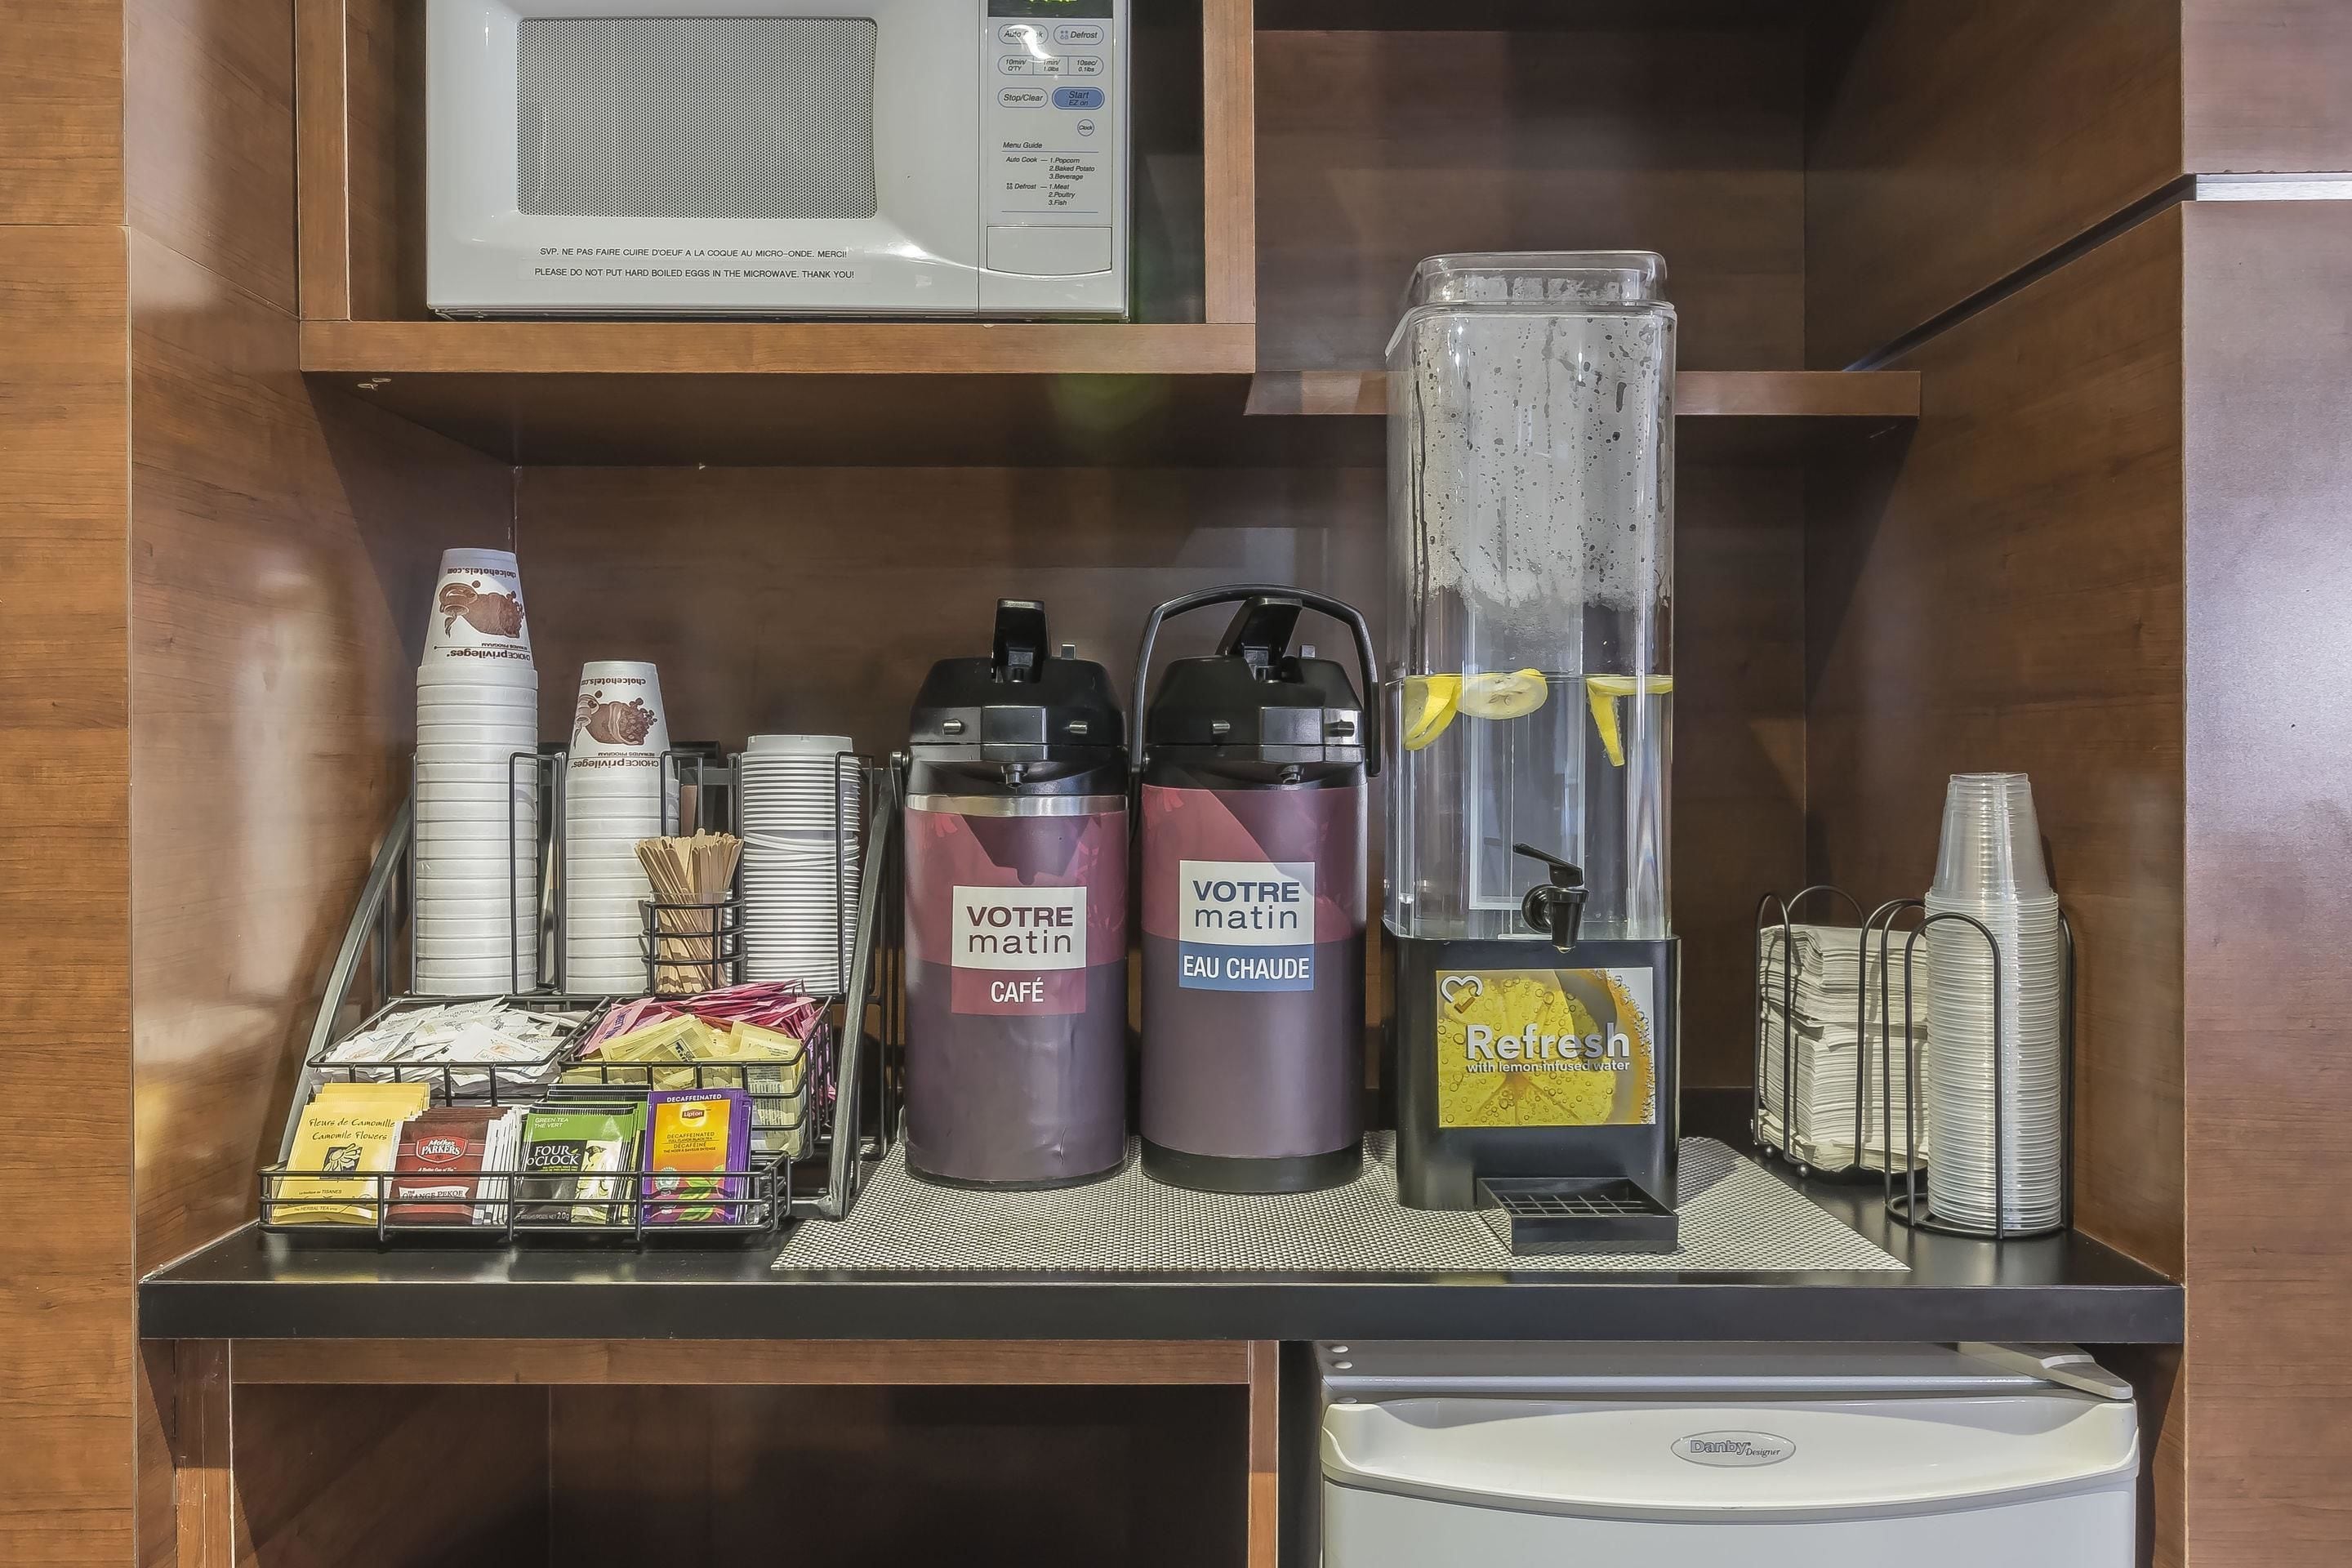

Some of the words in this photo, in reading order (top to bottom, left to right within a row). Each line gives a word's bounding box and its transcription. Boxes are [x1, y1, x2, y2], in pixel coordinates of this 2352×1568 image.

[1023, 30, 1044, 38] Ck
[1068, 91, 1089, 99] Start
[817, 250, 847, 258] MERCI!
[534, 268, 568, 276] PLEASE
[605, 269, 622, 277] PUT
[625, 269, 649, 277] HARD
[724, 270, 741, 278] THE
[833, 270, 854, 278] YOU!
[447, 568, 517, 579] choicehotels.com
[1192, 880, 1300, 903] VOTRE
[966, 906, 1074, 929] VOTRE
[1195, 905, 1298, 930] matin
[968, 929, 1073, 955] matin
[1183, 955, 1219, 979] EAU
[1226, 956, 1310, 982] CHAUDE
[991, 977, 1044, 1004] CAFÉ
[1466, 1022, 1631, 1060] Refresh
[1468, 1061, 1496, 1072] with
[1593, 1062, 1631, 1071] water
[666, 1094, 722, 1102] DECAFFEINATED
[310, 1118, 336, 1127] Fleurs
[337, 1118, 349, 1126] de
[351, 1118, 395, 1127] Camomille
[312, 1130, 352, 1140] Camomile
[355, 1131, 388, 1140] Flowers
[428, 1138, 456, 1147] Mother
[421, 1145, 461, 1156] PARKERS
[534, 1145, 579, 1156] FOUR
[1690, 1440, 1748, 1455] Danby
[1745, 1448, 1781, 1458] Designer
